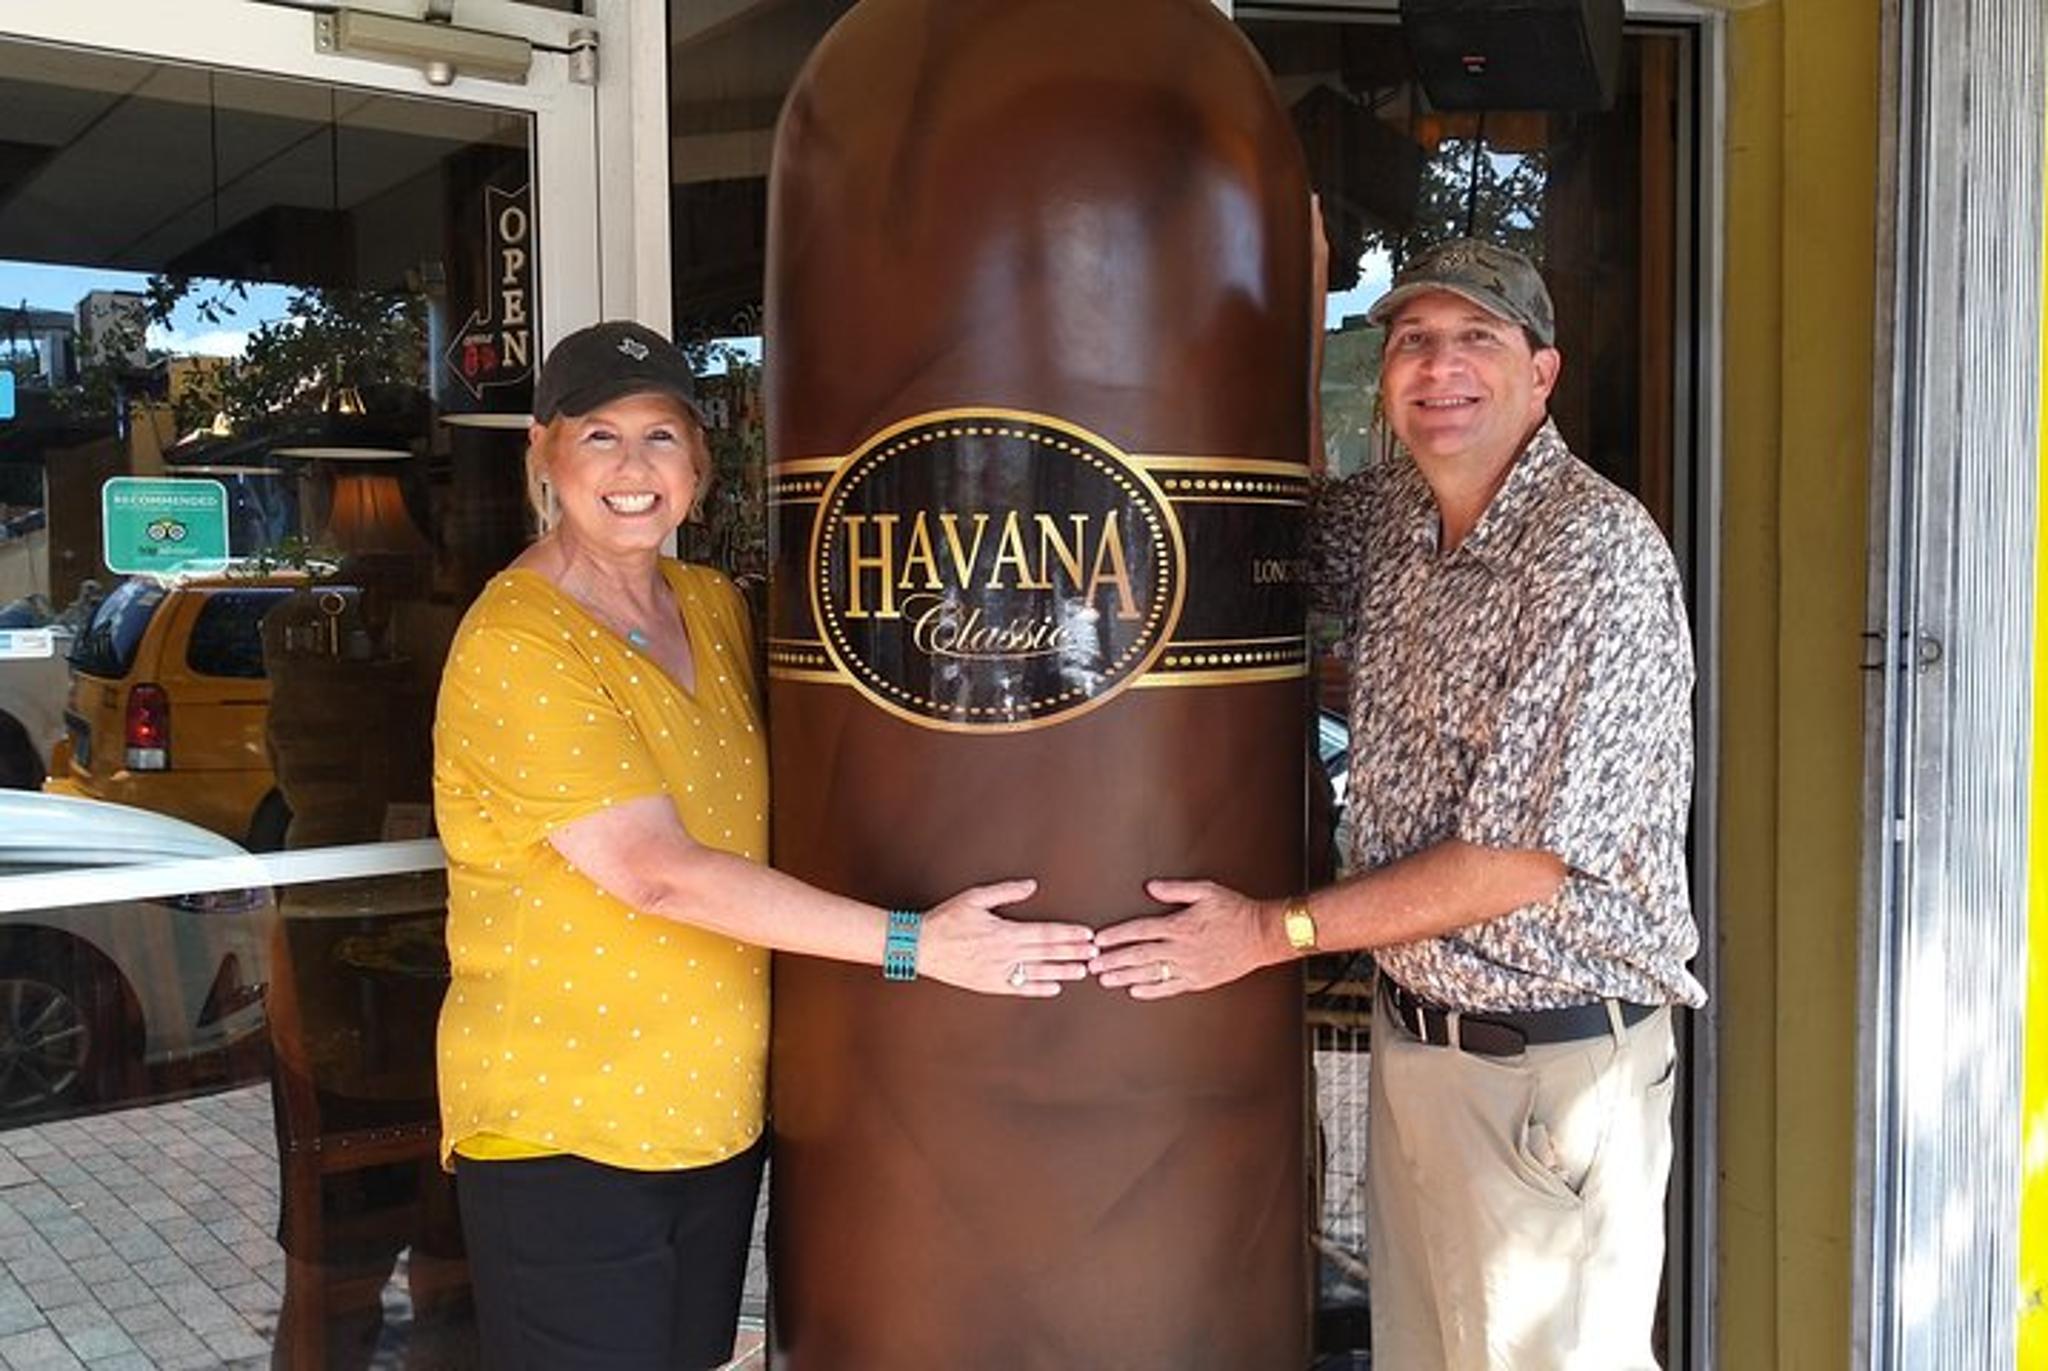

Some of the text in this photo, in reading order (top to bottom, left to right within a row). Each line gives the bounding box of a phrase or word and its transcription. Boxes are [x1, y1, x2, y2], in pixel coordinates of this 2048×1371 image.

[498, 205, 529, 367] OPEN
[113, 494, 218, 507] RECOMMENDED
[841, 509, 1141, 620] HAVANA
[900, 592, 1072, 661] Classic
